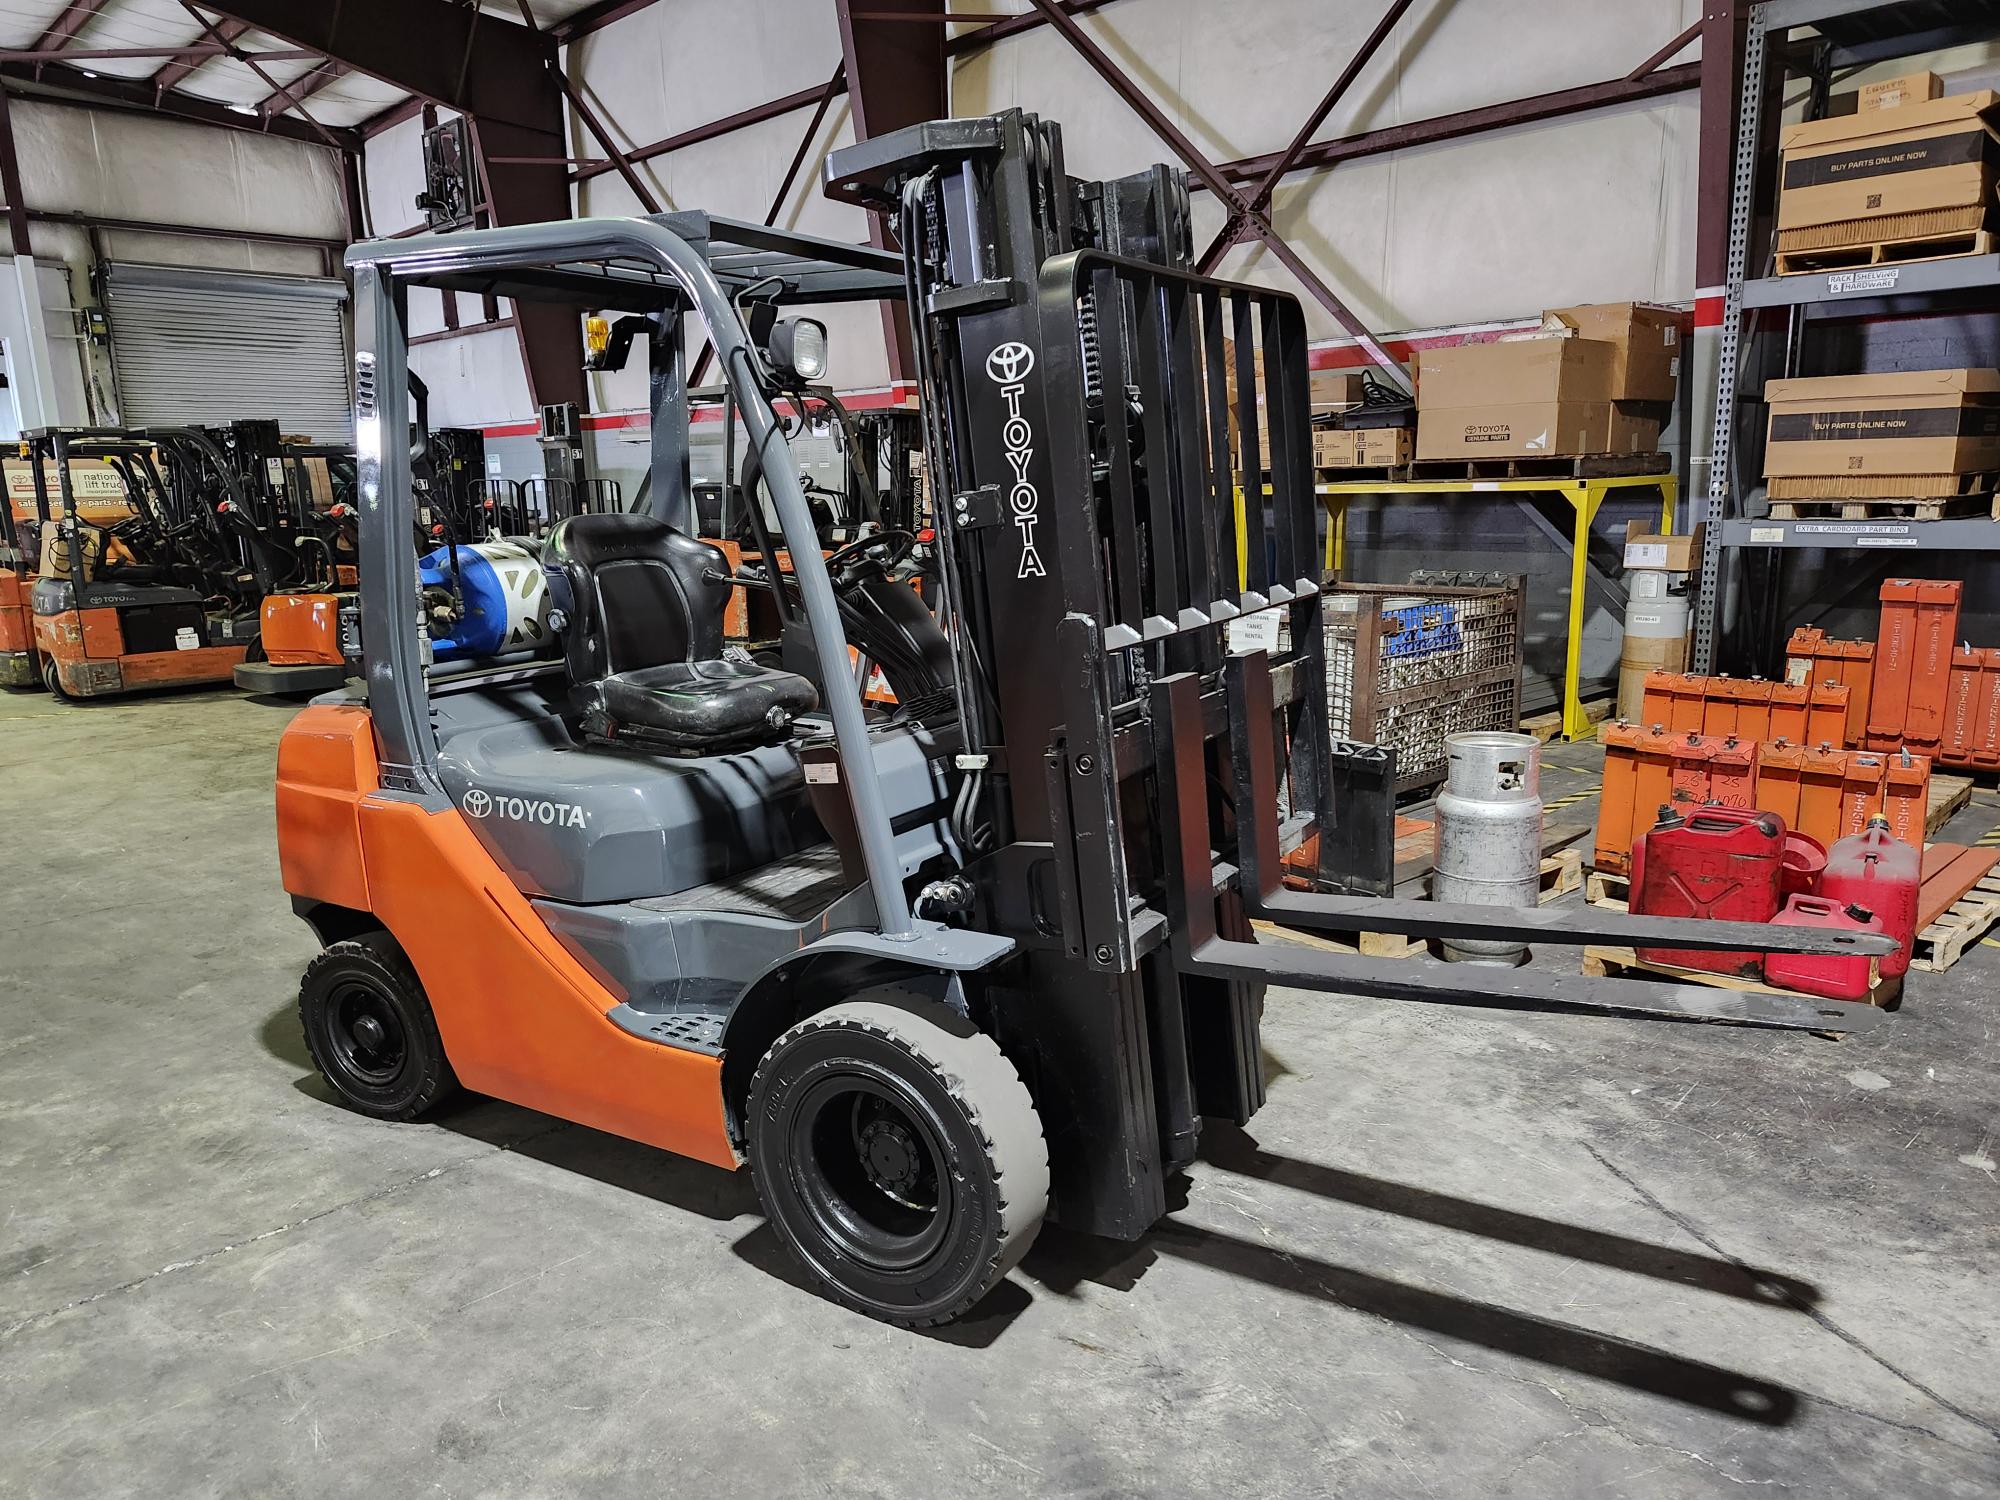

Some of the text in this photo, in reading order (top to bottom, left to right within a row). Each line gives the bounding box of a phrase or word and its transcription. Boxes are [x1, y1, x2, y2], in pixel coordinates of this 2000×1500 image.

[1830, 150, 1928, 173] BUY PARTS ONLINE NOW
[1830, 270, 1897, 283] RACK SHELVING
[1844, 280, 1893, 291] HARDWARE
[1478, 424, 1511, 433] TOYOTA
[1814, 423, 1830, 431] BUY
[1856, 421, 1886, 429] ONLINE
[1886, 420, 1907, 428] NOW
[85, 480, 99, 489] lift
[1000, 383, 1047, 579] TOYOTA
[88, 499, 111, 508] parts
[914, 479, 922, 532] TOYOTA
[1822, 525, 1867, 533] CARDBOARD
[1244, 632, 1264, 640] RENTAL
[495, 795, 587, 829] TOYOTA
